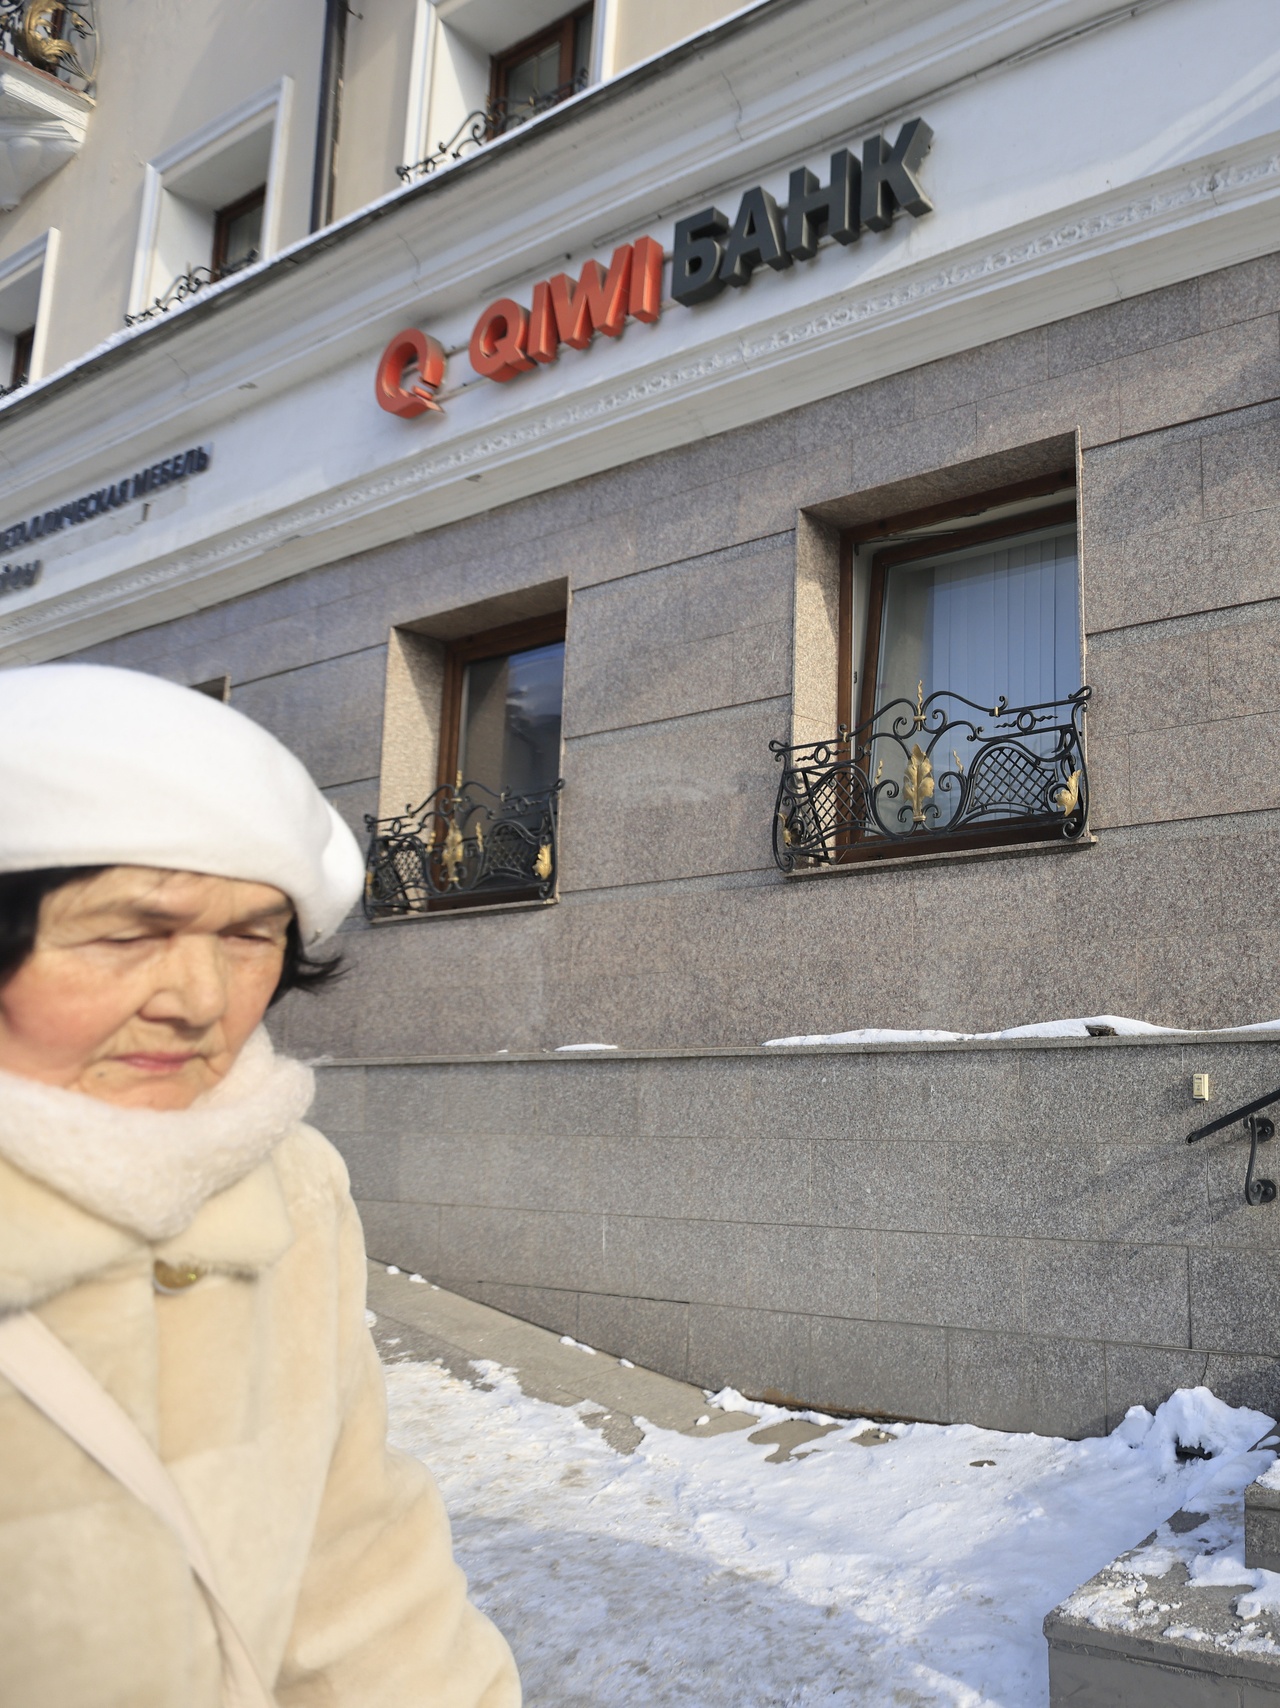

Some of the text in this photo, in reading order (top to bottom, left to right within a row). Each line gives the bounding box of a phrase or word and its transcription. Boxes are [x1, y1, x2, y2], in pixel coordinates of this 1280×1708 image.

[468, 235, 664, 383] QIWI
[670, 117, 935, 308] БАНК
[133, 445, 210, 497] МЕБЕЛЬ
